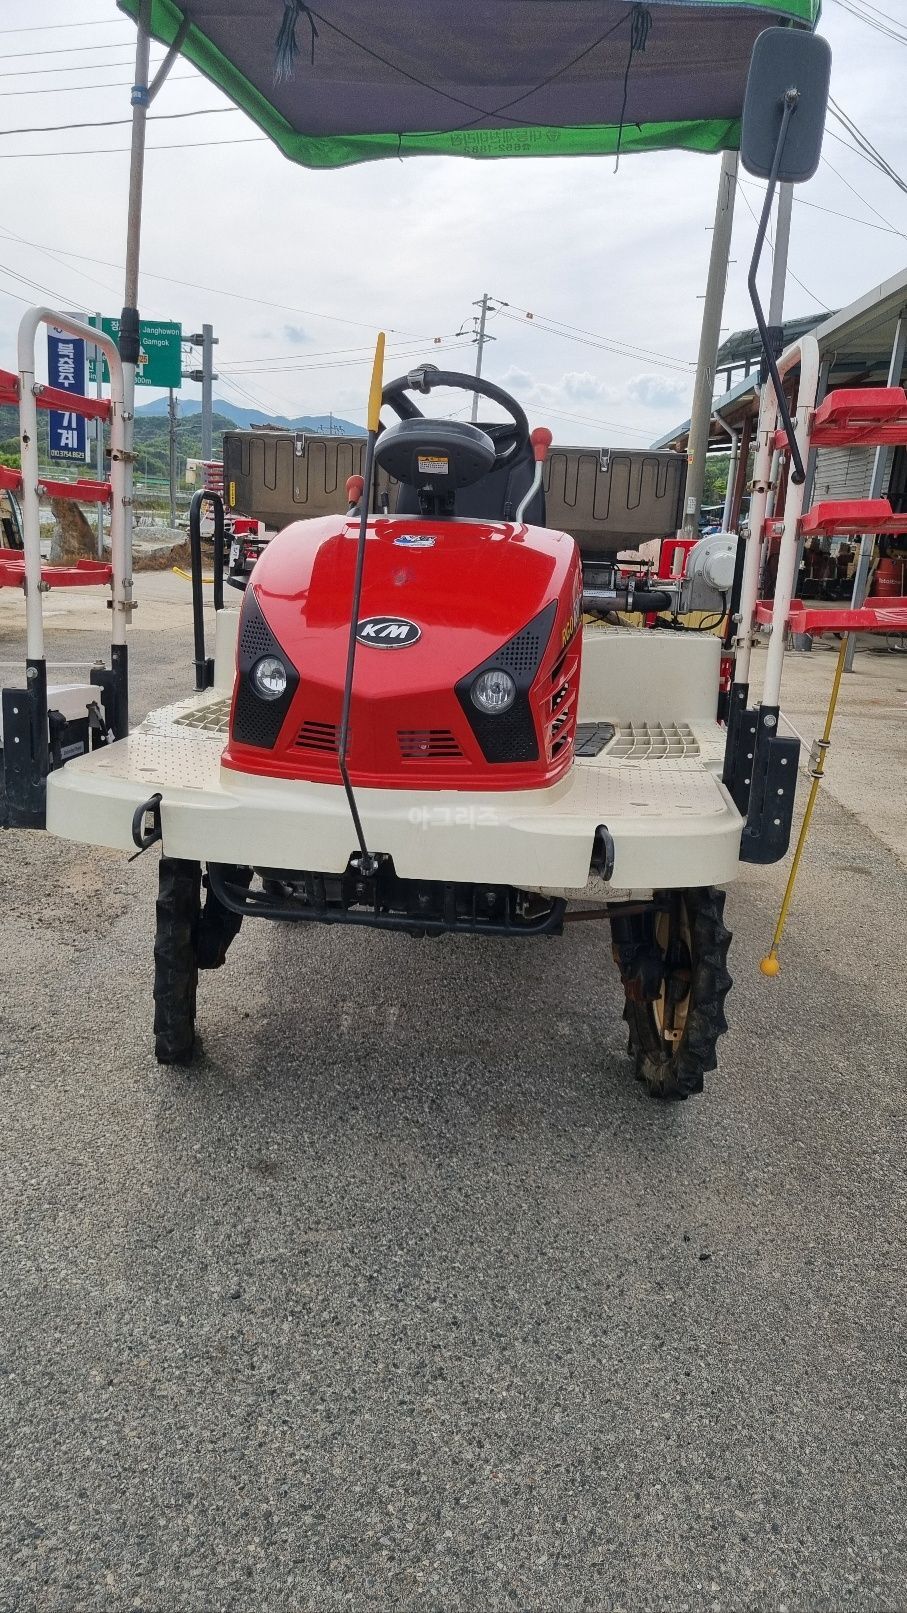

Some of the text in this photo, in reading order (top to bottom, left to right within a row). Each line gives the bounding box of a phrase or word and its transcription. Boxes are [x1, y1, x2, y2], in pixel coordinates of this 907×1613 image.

[142, 326, 180, 336] Janghowon
[142, 338, 170, 346] Gamgok
[58, 342, 75, 387] 북충주
[58, 411, 78, 448] 기계
[361, 622, 410, 639] KM
